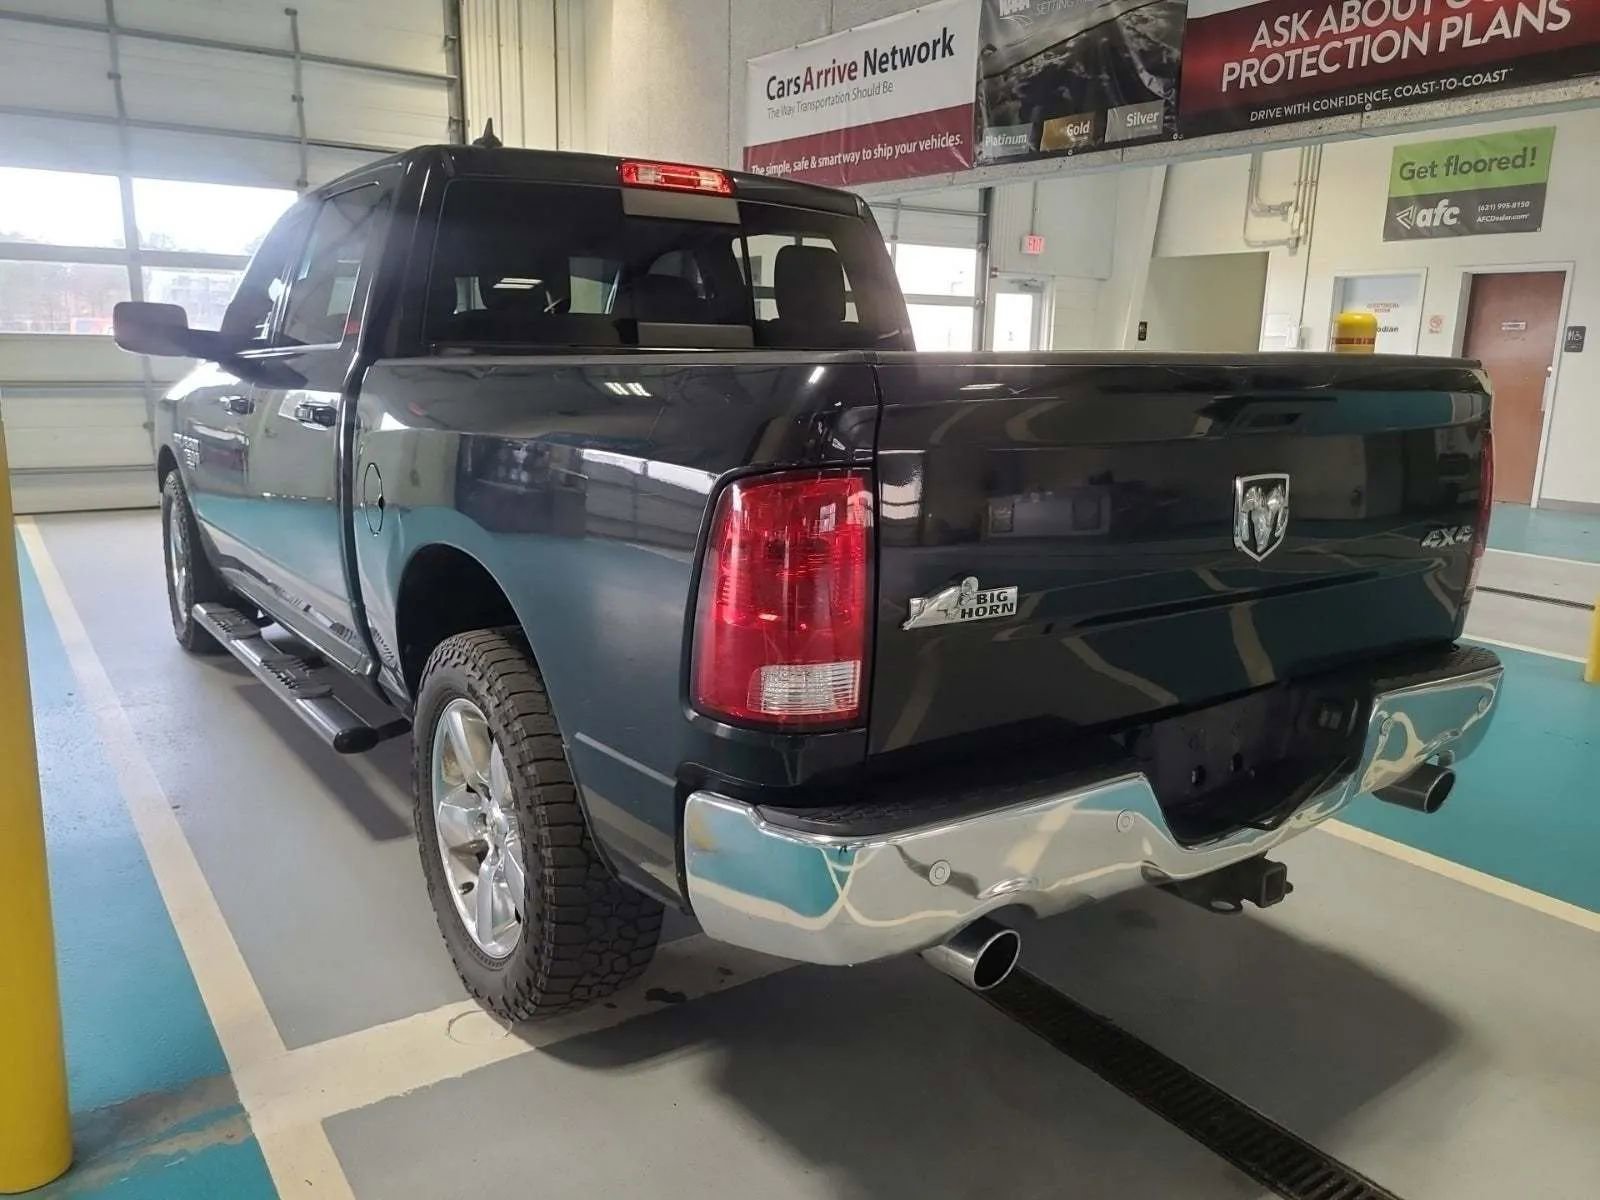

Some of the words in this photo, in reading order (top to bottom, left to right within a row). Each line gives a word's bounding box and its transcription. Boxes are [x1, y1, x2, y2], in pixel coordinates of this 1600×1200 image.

[863, 27, 955, 77] Network
[1222, 21, 1431, 92] PROTECTION
[1438, 0, 1572, 52] PLANS
[1250, 20, 1313, 53] ASK
[768, 107, 780, 119] The
[781, 105, 796, 117] Way
[797, 91, 850, 114] Transportation
[852, 83, 881, 101] Should
[882, 81, 894, 94] Be
[1250, 107, 1283, 122] DRIVE
[1283, 103, 1310, 117] WITH
[1312, 89, 1392, 112] CONFIDENCE,
[1066, 121, 1090, 137] Gold
[1126, 111, 1159, 127] Silver
[751, 164, 765, 176] The
[766, 160, 792, 177] simple,
[793, 156, 809, 171] safe
[811, 155, 818, 169] &
[818, 155, 842, 168] smart
[843, 151, 861, 164] way
[862, 148, 872, 160] to
[873, 145, 893, 160] ship
[894, 141, 918, 159] your
[918, 131, 964, 150] vehicles.
[985, 132, 1028, 147] Platinum
[1399, 160, 1438, 181] Get
[1444, 146, 1537, 177] floored!
[1416, 199, 1460, 227] afc
[961, 602, 1014, 619] HORN
[976, 591, 1008, 605] BIG
